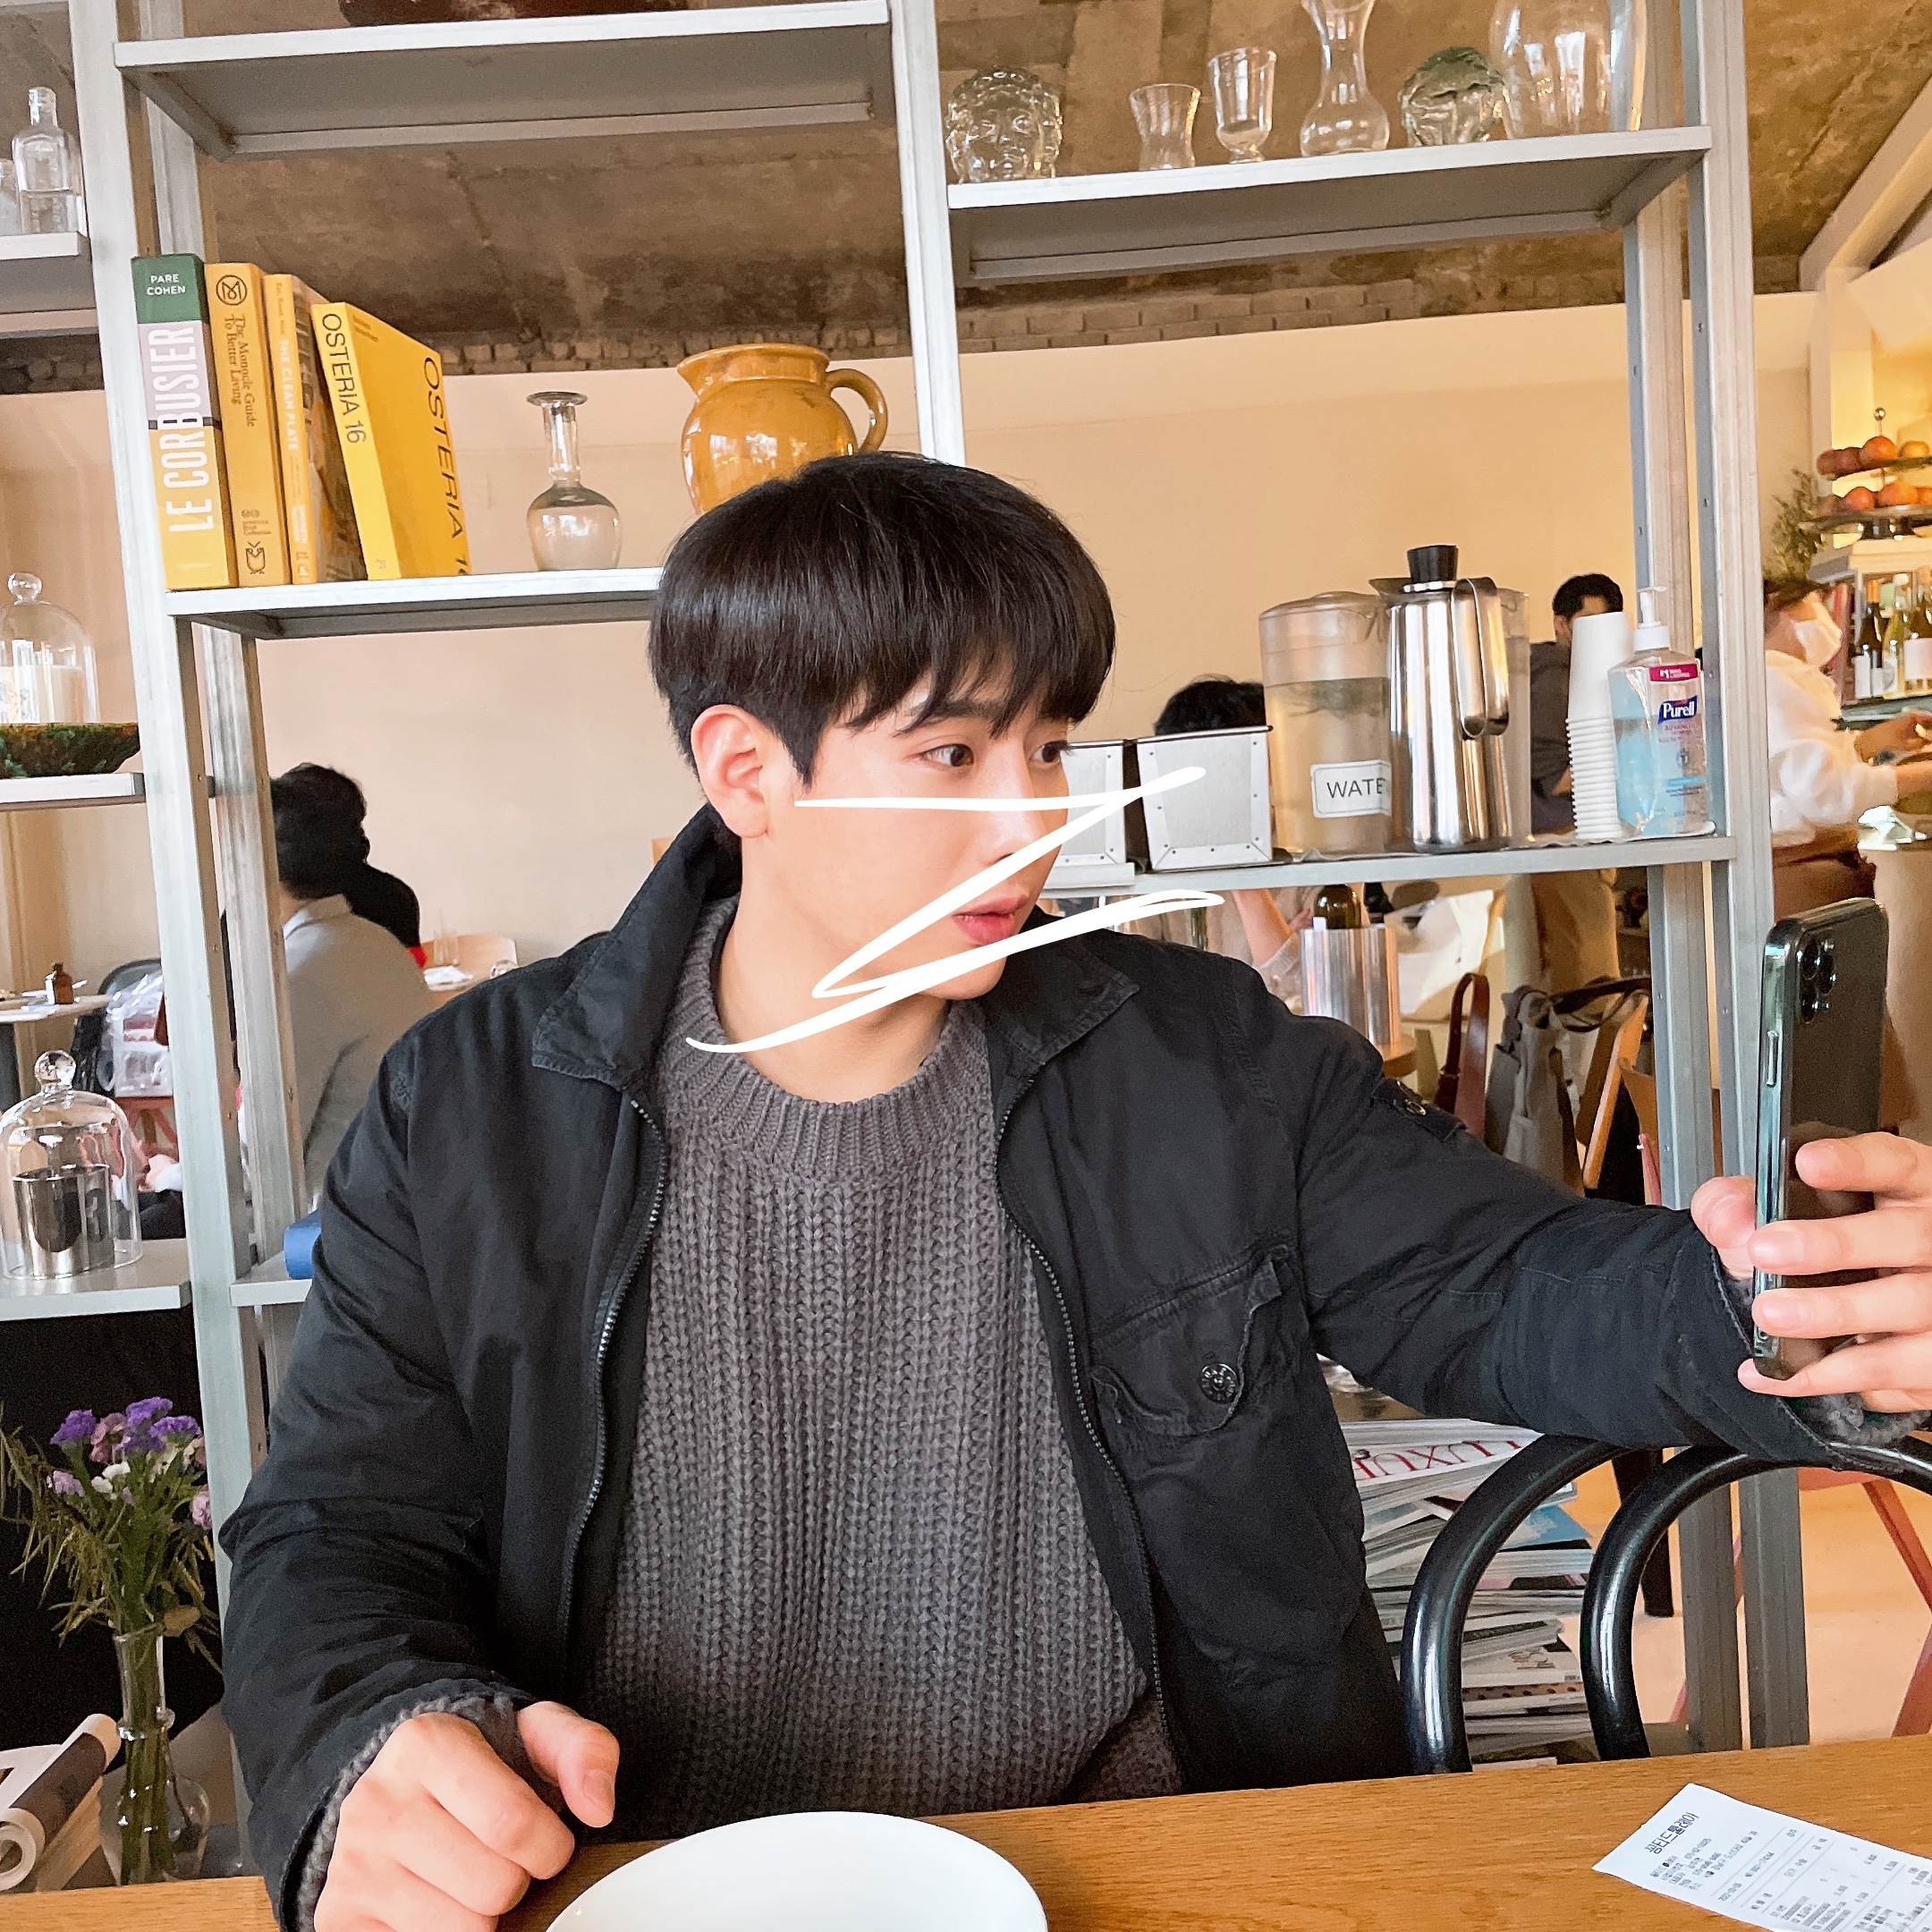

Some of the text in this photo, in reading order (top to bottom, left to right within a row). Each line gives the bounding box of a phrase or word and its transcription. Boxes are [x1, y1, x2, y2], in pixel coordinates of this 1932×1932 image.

[146, 284, 187, 296] COHEN
[149, 273, 180, 284] PARE
[225, 313, 242, 406] To Better Living
[234, 313, 257, 427] The Monocle Guide
[322, 313, 368, 445] OSTERIA 16
[282, 369, 296, 411] CLEAN
[148, 326, 216, 532] LE CORBUSIER
[286, 412, 299, 452] PLATE
[424, 357, 463, 539] OSTERIA
[1662, 700, 1695, 719] Purell
[1326, 776, 1387, 799] WATE
